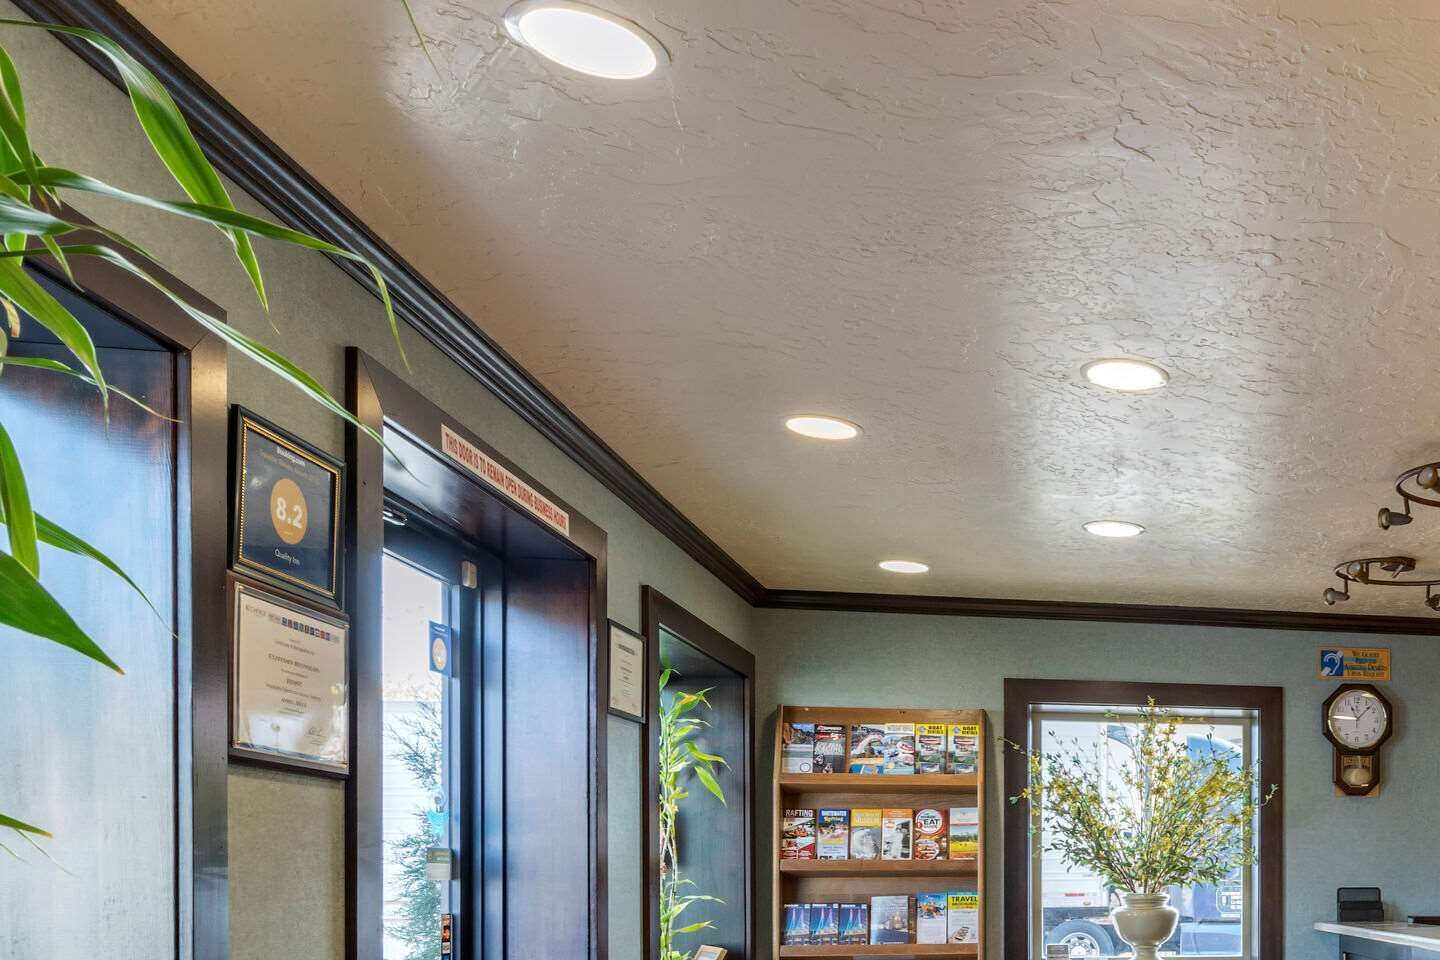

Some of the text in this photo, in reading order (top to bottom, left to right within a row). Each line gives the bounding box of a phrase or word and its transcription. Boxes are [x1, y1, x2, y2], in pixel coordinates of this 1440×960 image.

[445, 432, 458, 451] THIS
[458, 440, 474, 464] DOOR
[473, 450, 479, 469] IS
[479, 453, 486, 474] TO
[487, 458, 505, 487] REMAIN
[505, 472, 517, 497] OPEN
[517, 480, 534, 508] DURING
[534, 492, 553, 521] BUSINESS
[276, 497, 304, 529] 8.2
[785, 809, 814, 817] RAFTING
